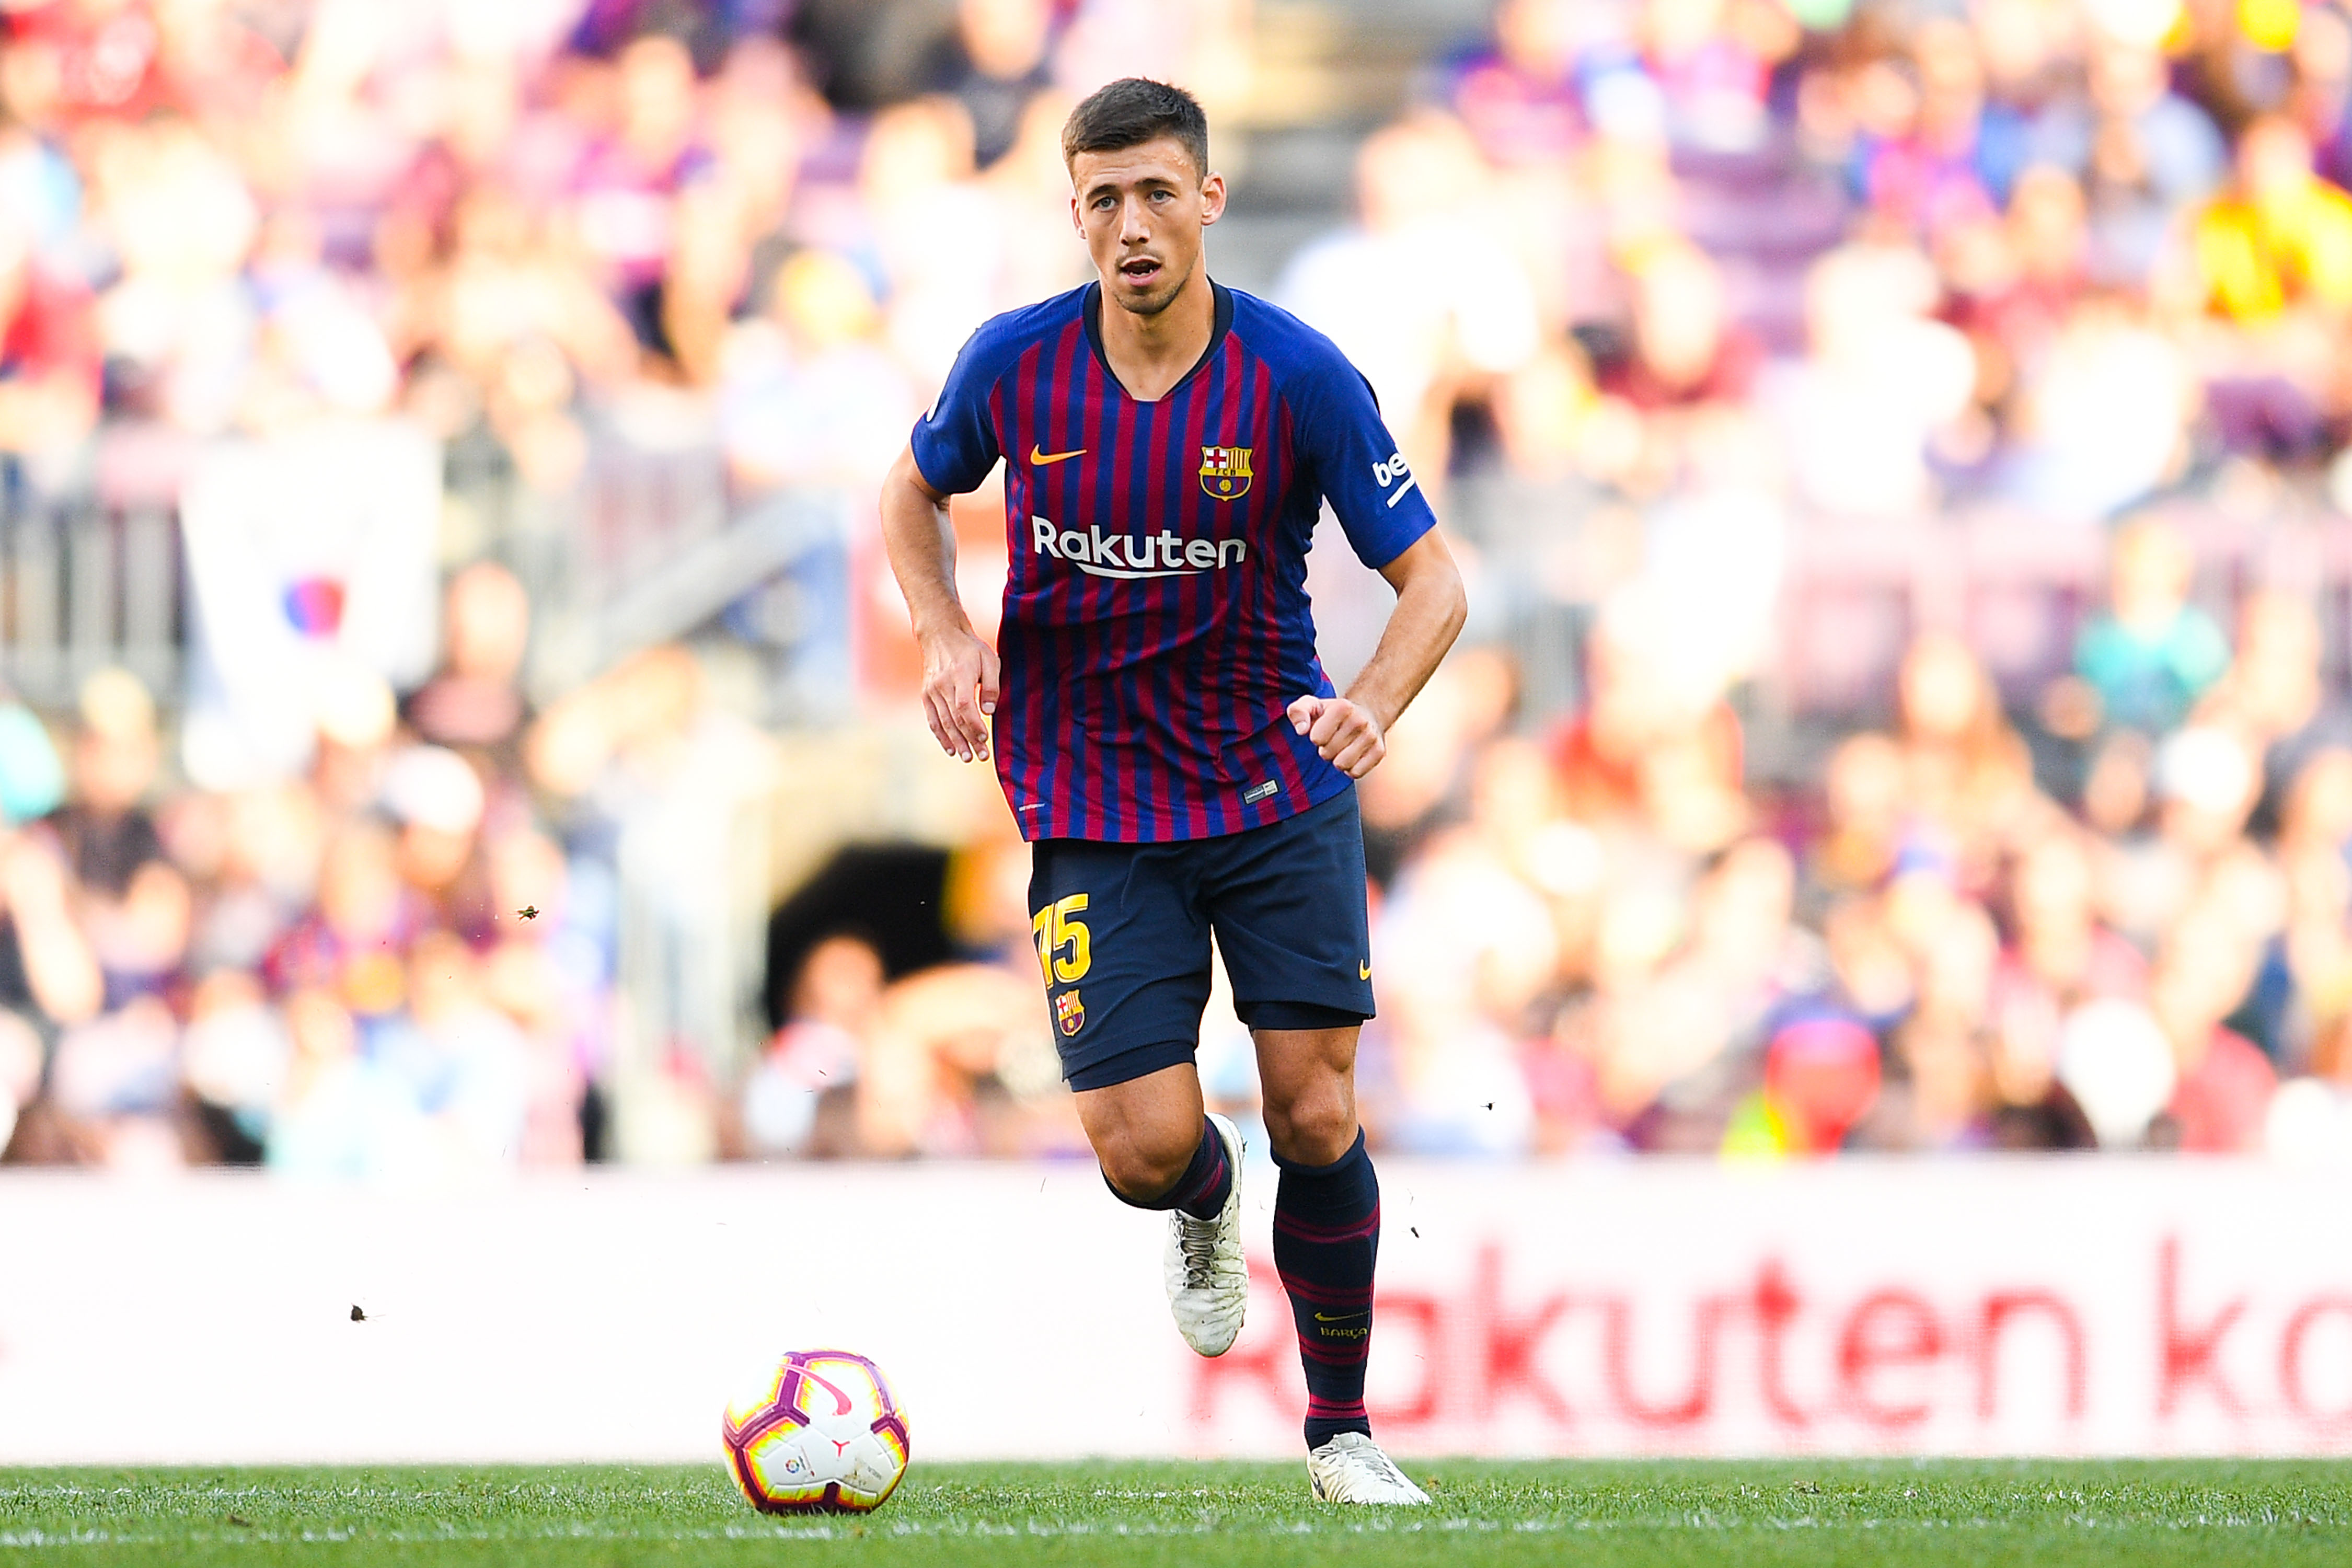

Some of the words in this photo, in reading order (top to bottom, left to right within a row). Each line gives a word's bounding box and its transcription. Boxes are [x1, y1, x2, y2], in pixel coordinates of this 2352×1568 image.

[1372, 453, 1408, 487] be
[1032, 515, 1247, 569] Rakuten
[1032, 893, 1091, 989] 15
[1321, 1327, 1367, 1339] BARÇA
